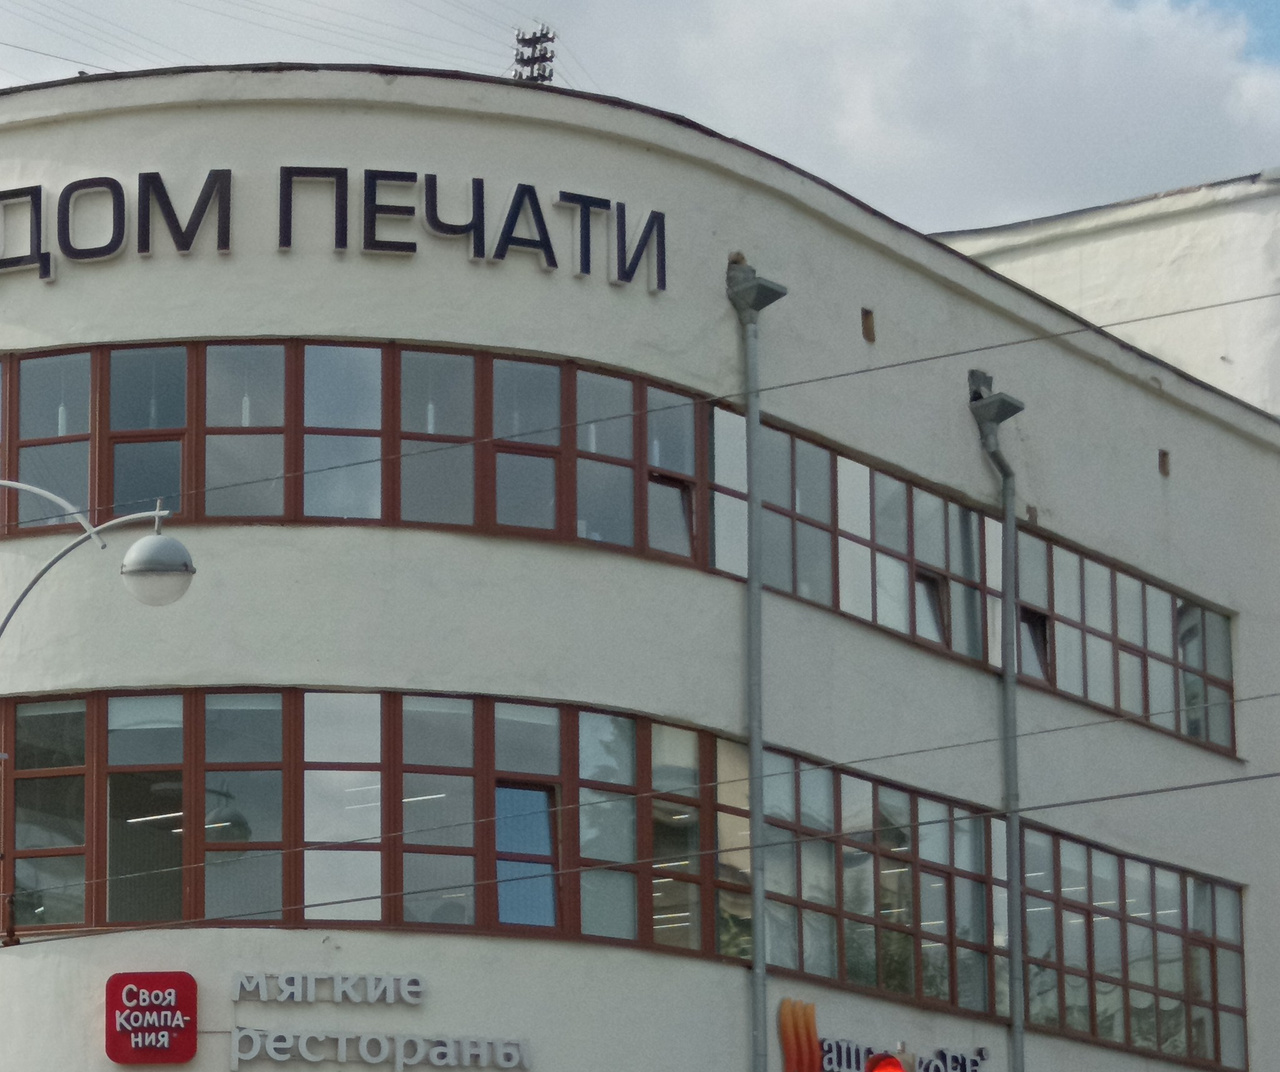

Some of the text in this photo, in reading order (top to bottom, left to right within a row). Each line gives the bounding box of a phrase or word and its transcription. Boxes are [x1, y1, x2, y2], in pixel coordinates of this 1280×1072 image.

[277, 166, 667, 293] ПЕЧАТИ
[122, 984, 176, 1007] Своя
[235, 973, 424, 1005] мягкие
